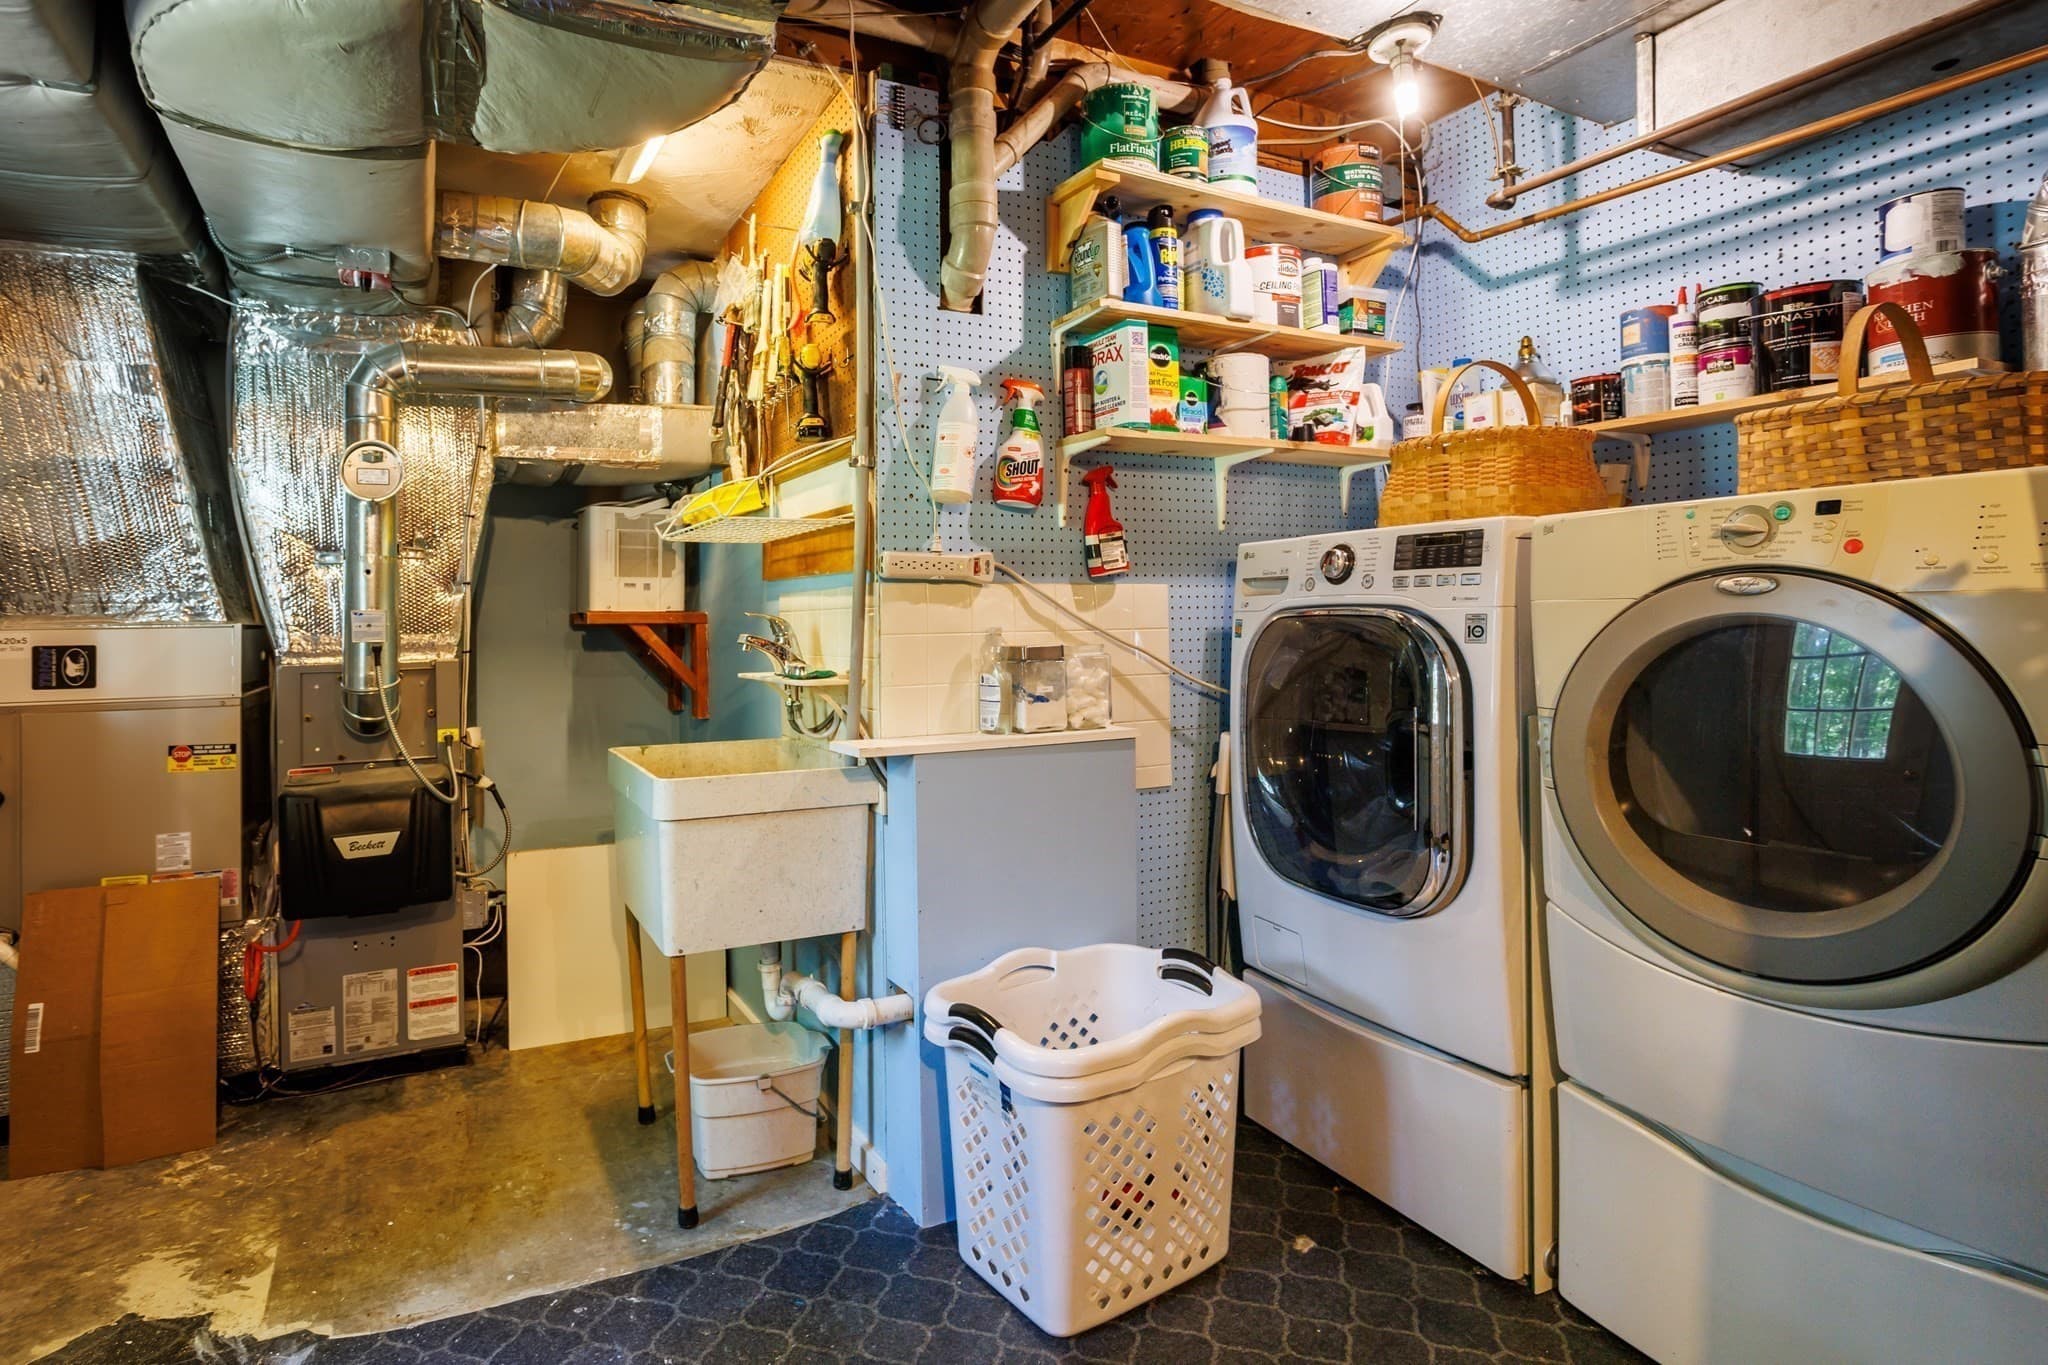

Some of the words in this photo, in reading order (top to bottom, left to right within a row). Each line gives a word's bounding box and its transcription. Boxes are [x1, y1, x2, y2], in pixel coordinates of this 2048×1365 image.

[1260, 280, 1293, 290] CEILING
[1762, 307, 1834, 328] DYNASTY
[1089, 343, 1124, 369] ORAX
[1149, 378, 1161, 387] ant
[1005, 459, 1040, 477] SHOUT
[348, 839, 386, 852] Beckett
